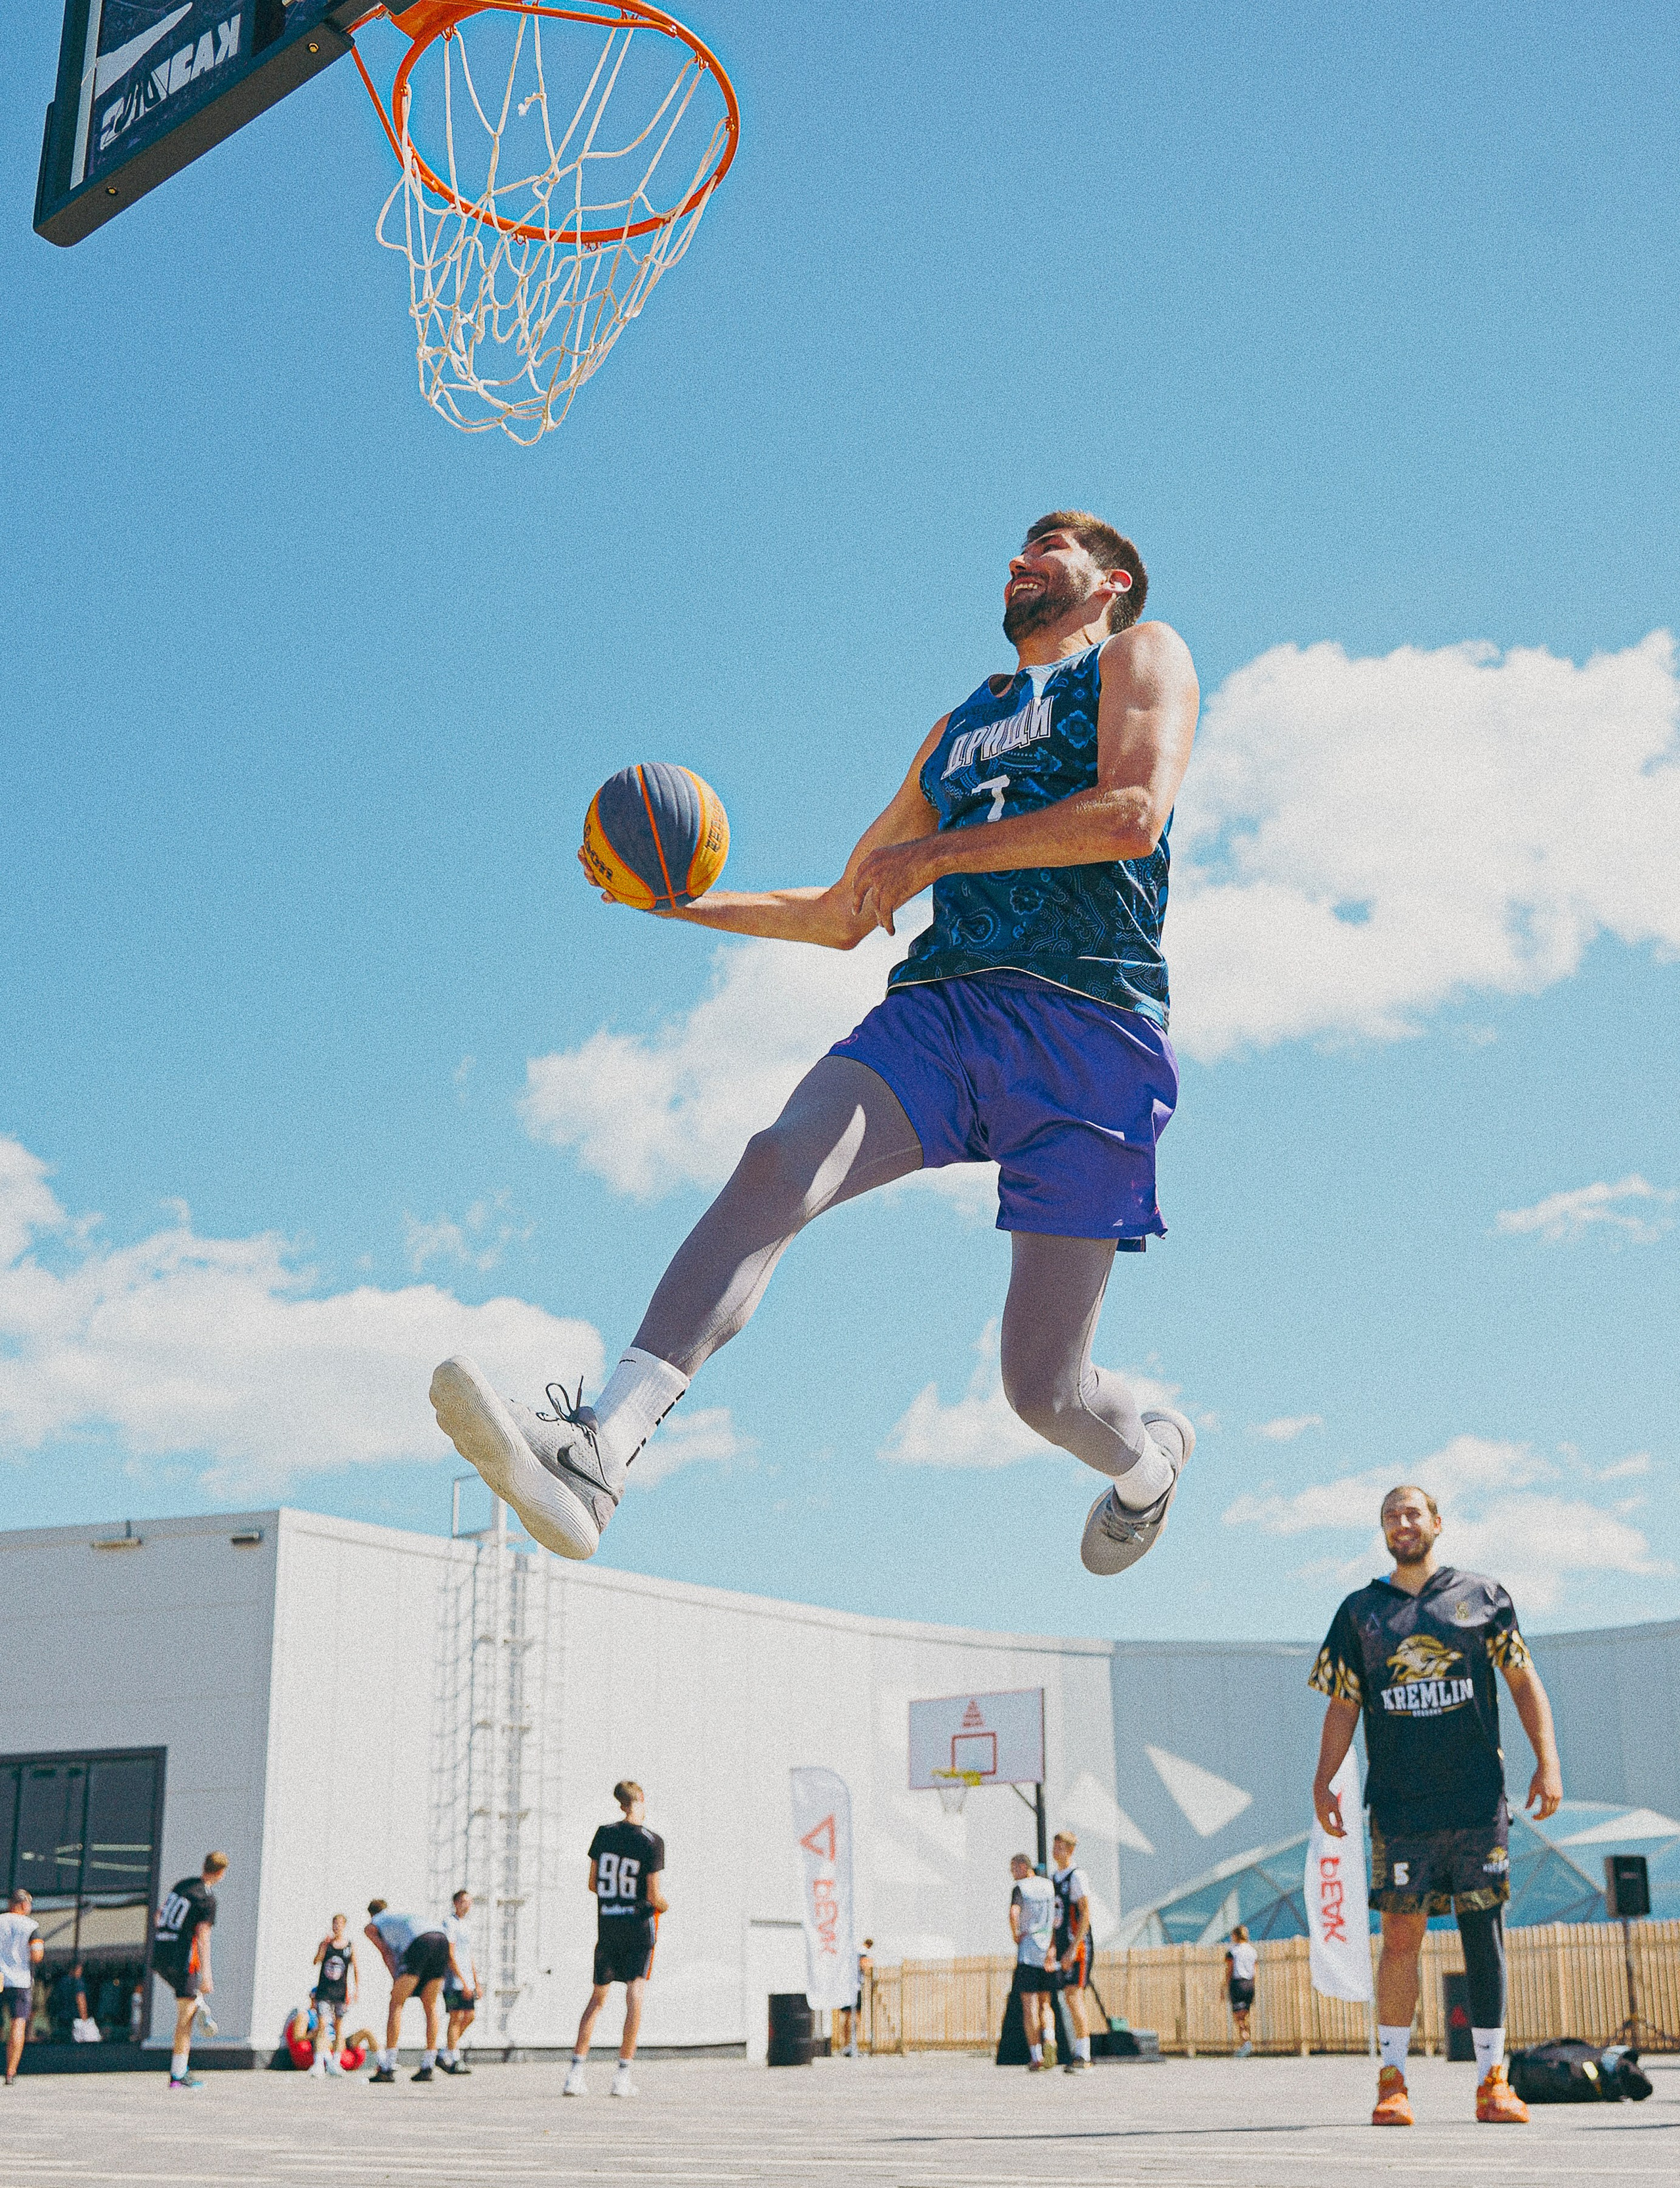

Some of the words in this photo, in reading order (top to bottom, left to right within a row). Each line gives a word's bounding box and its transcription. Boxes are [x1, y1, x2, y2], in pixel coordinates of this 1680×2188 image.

[941, 696, 1054, 780] ДРИЩИ
[971, 774, 1011, 822] 7
[1381, 1678, 1475, 1710] KREMLIN
[598, 1853, 640, 1899] 96
[1393, 1861, 1410, 1885] 5
